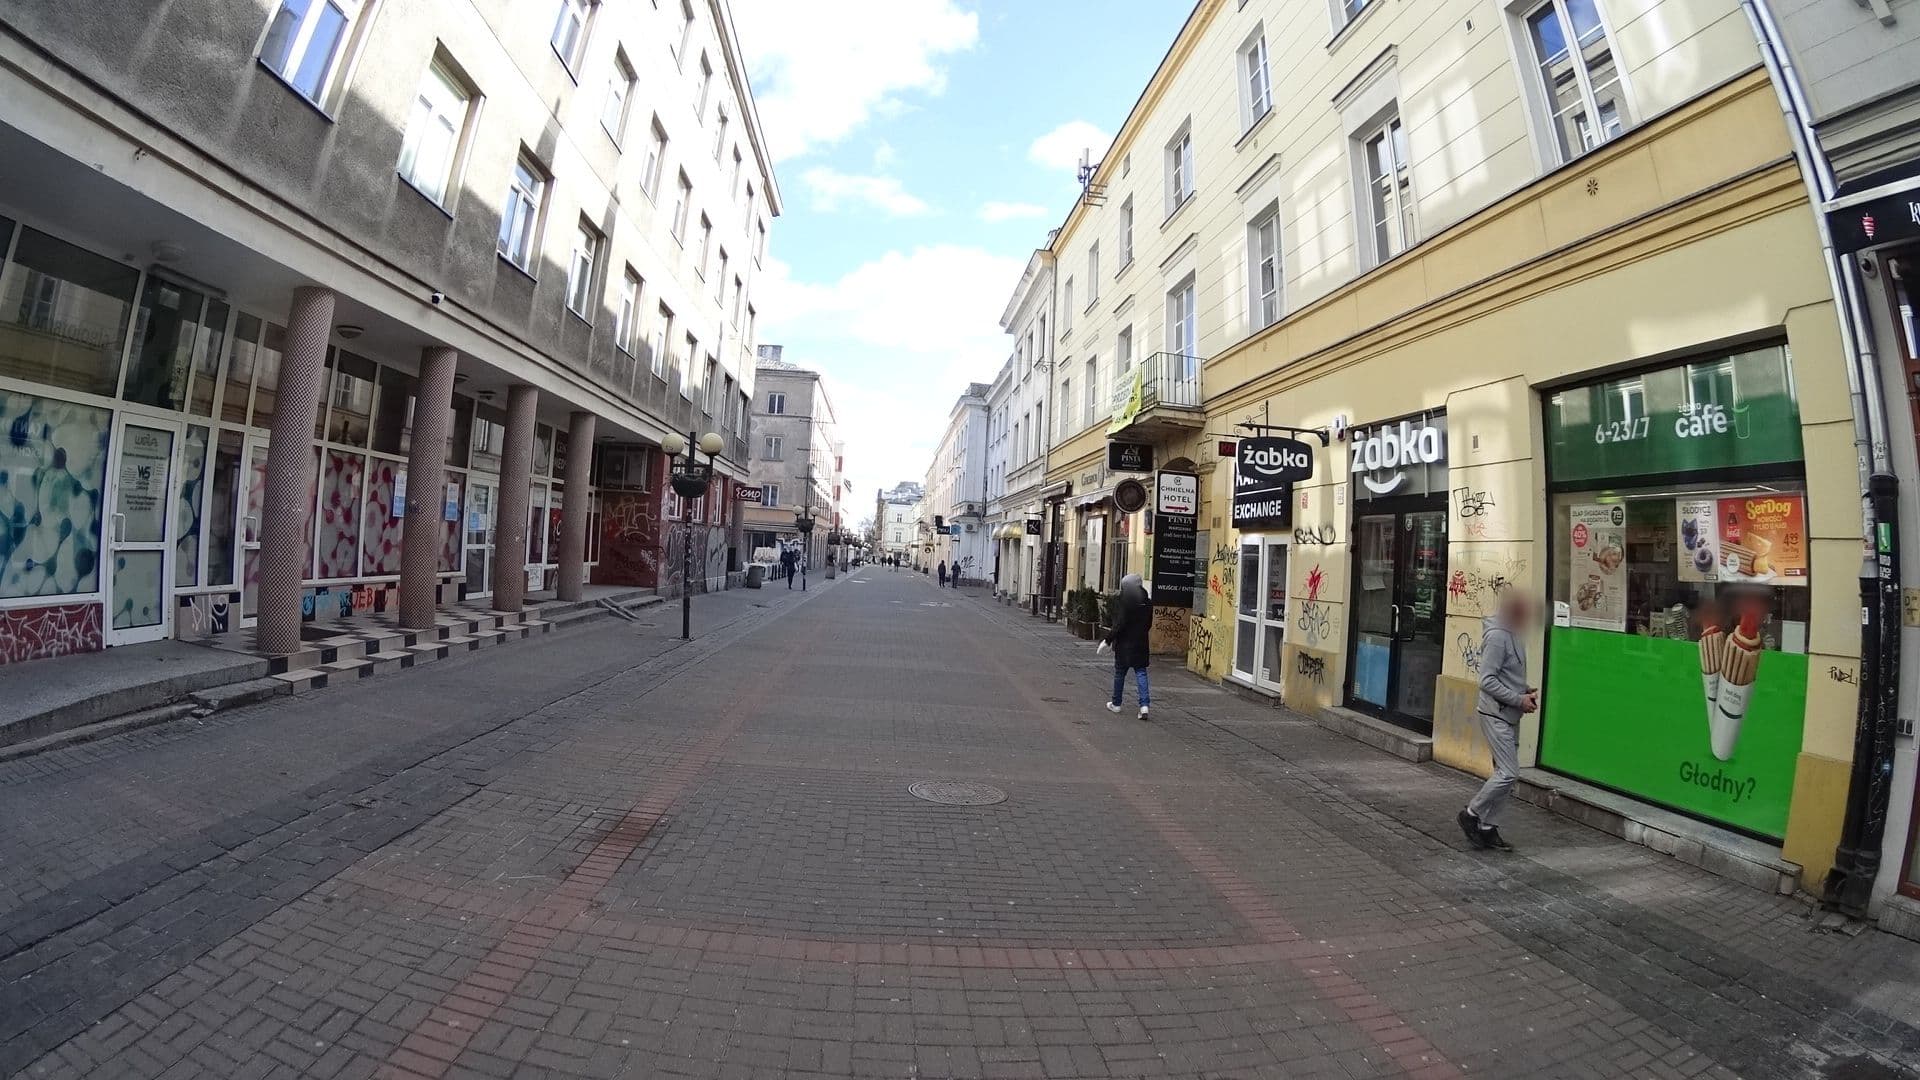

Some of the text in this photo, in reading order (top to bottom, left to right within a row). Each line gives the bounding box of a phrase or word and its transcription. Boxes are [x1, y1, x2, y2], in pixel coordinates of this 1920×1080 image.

[1595, 416, 1650, 444] 6-23/7
[1243, 445, 1309, 468] żabka
[1351, 421, 1444, 473] żabka
[1160, 486, 1195, 494] CHMIELNA
[1164, 494, 1192, 504] HOTEL
[1234, 500, 1282, 519] EXCHANGE
[1745, 499, 1792, 520] SerDog
[1680, 761, 1757, 803] Głodny?
